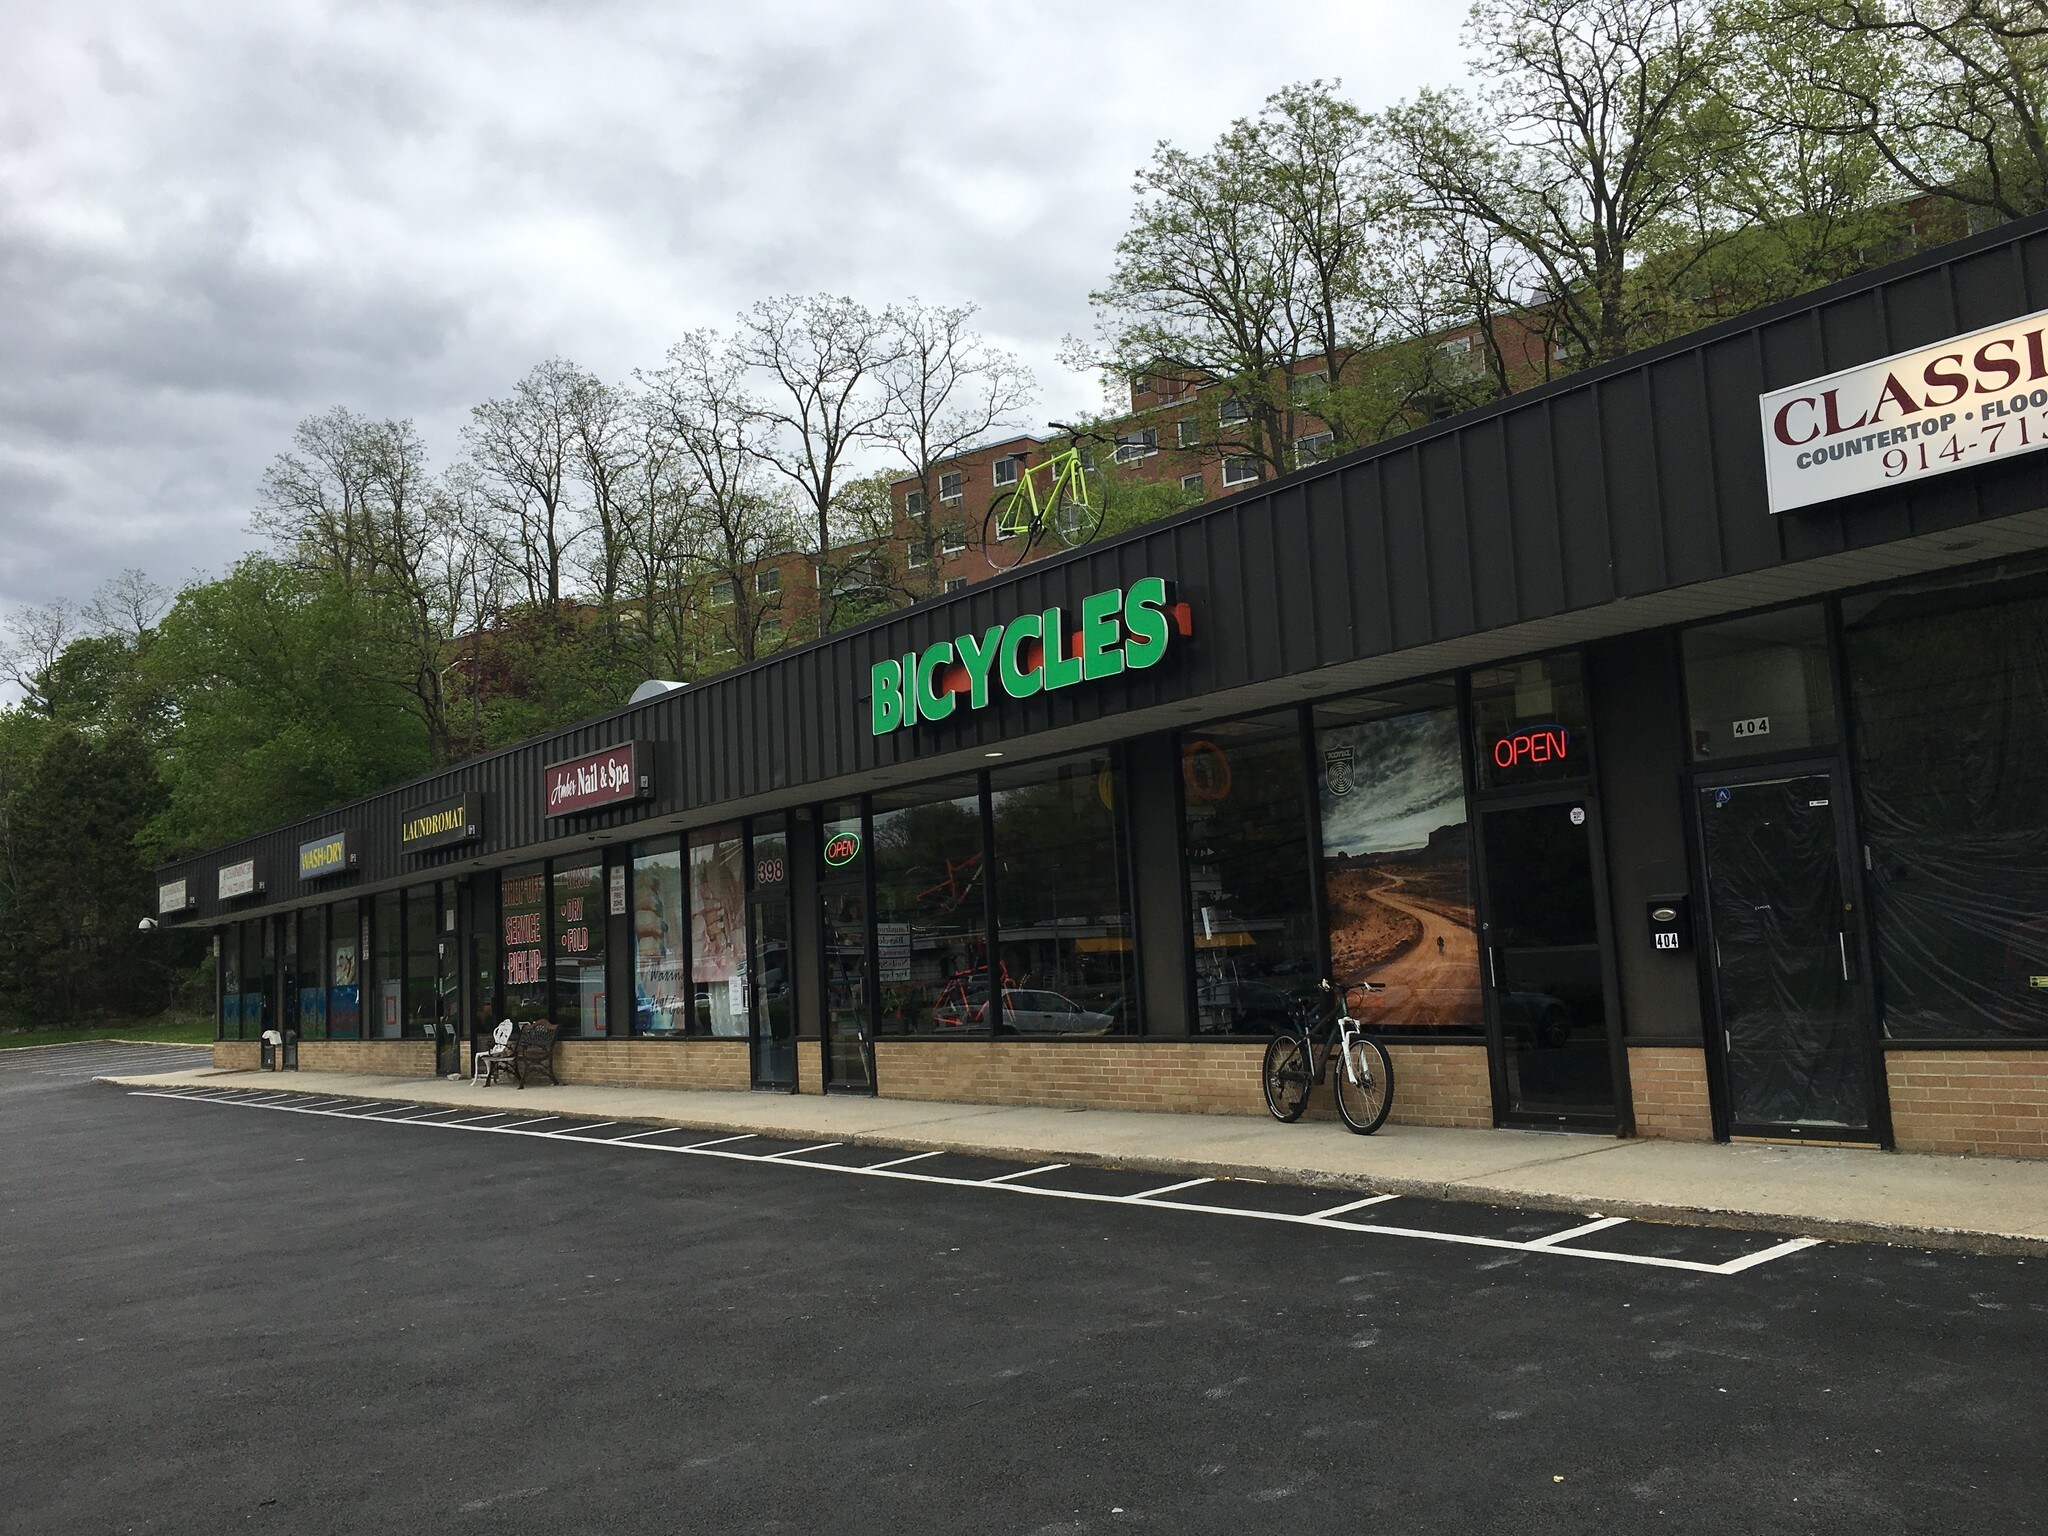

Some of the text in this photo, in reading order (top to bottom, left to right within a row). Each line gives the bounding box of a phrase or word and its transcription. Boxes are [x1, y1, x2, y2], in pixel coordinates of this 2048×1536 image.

[1796, 388, 2048, 470] COUNTERTOP FLOO
[1882, 410, 2048, 478] 914-71
[872, 577, 1168, 736] BICYCLES
[1735, 720, 1768, 735] 404
[1495, 730, 1566, 767] OPEN
[550, 758, 630, 806] Amber Nail & Spa
[403, 807, 464, 842] LAUNDROMAT
[828, 840, 855, 858] OPEN
[566, 865, 590, 889] WASH
[758, 858, 783, 883] 398
[567, 897, 584, 921] DRY
[505, 913, 541, 945] SERVICE
[567, 927, 589, 952] FOLD
[1657, 933, 1678, 948] 404
